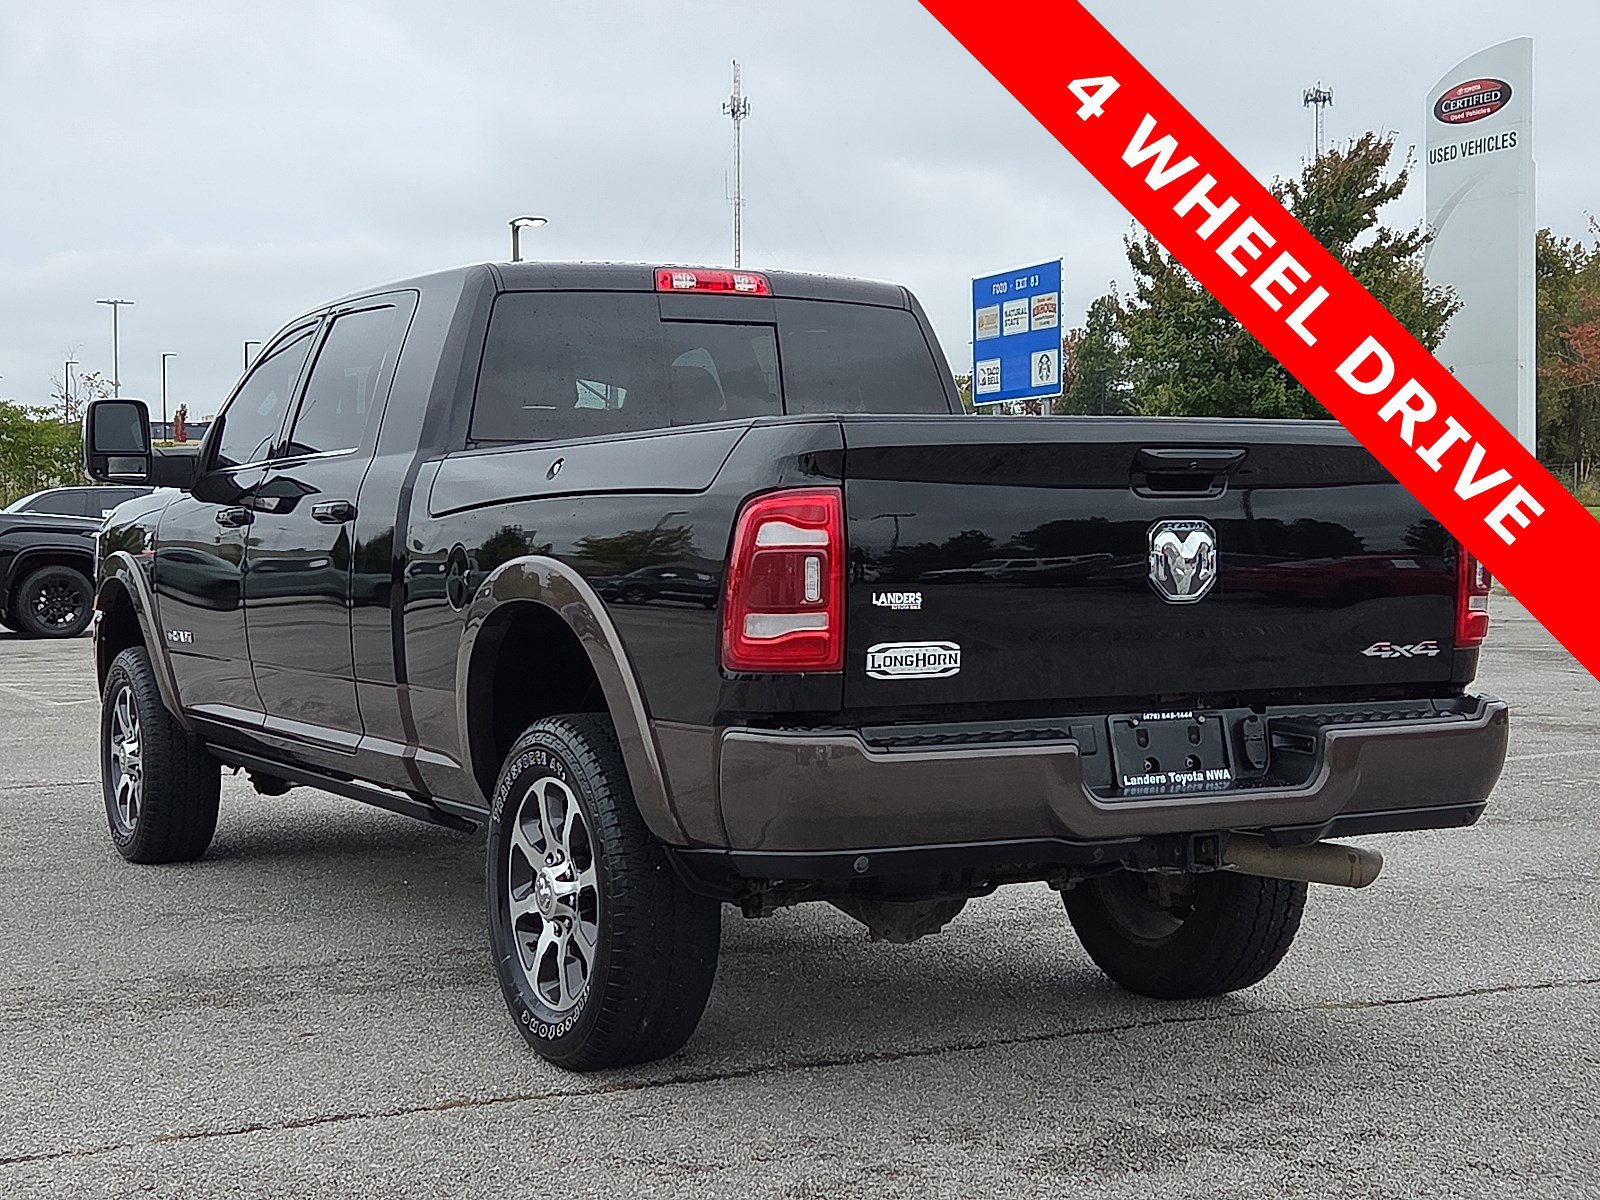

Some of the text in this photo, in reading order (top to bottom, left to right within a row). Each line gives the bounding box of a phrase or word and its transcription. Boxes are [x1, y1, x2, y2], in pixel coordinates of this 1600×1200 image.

[1441, 91, 1501, 112] CERTIFIED
[1430, 132, 1517, 165] USED VEHICLES
[992, 282, 1007, 295] FOOD
[1015, 277, 1027, 290] EXIT
[1004, 307, 1027, 318] NATURAL
[1004, 317, 1020, 327] STATE
[987, 366, 999, 376] TACO
[987, 376, 999, 385] BELL
[872, 592, 922, 606] LANDERS
[1123, 768, 1231, 787] Landers Toyota NWA
